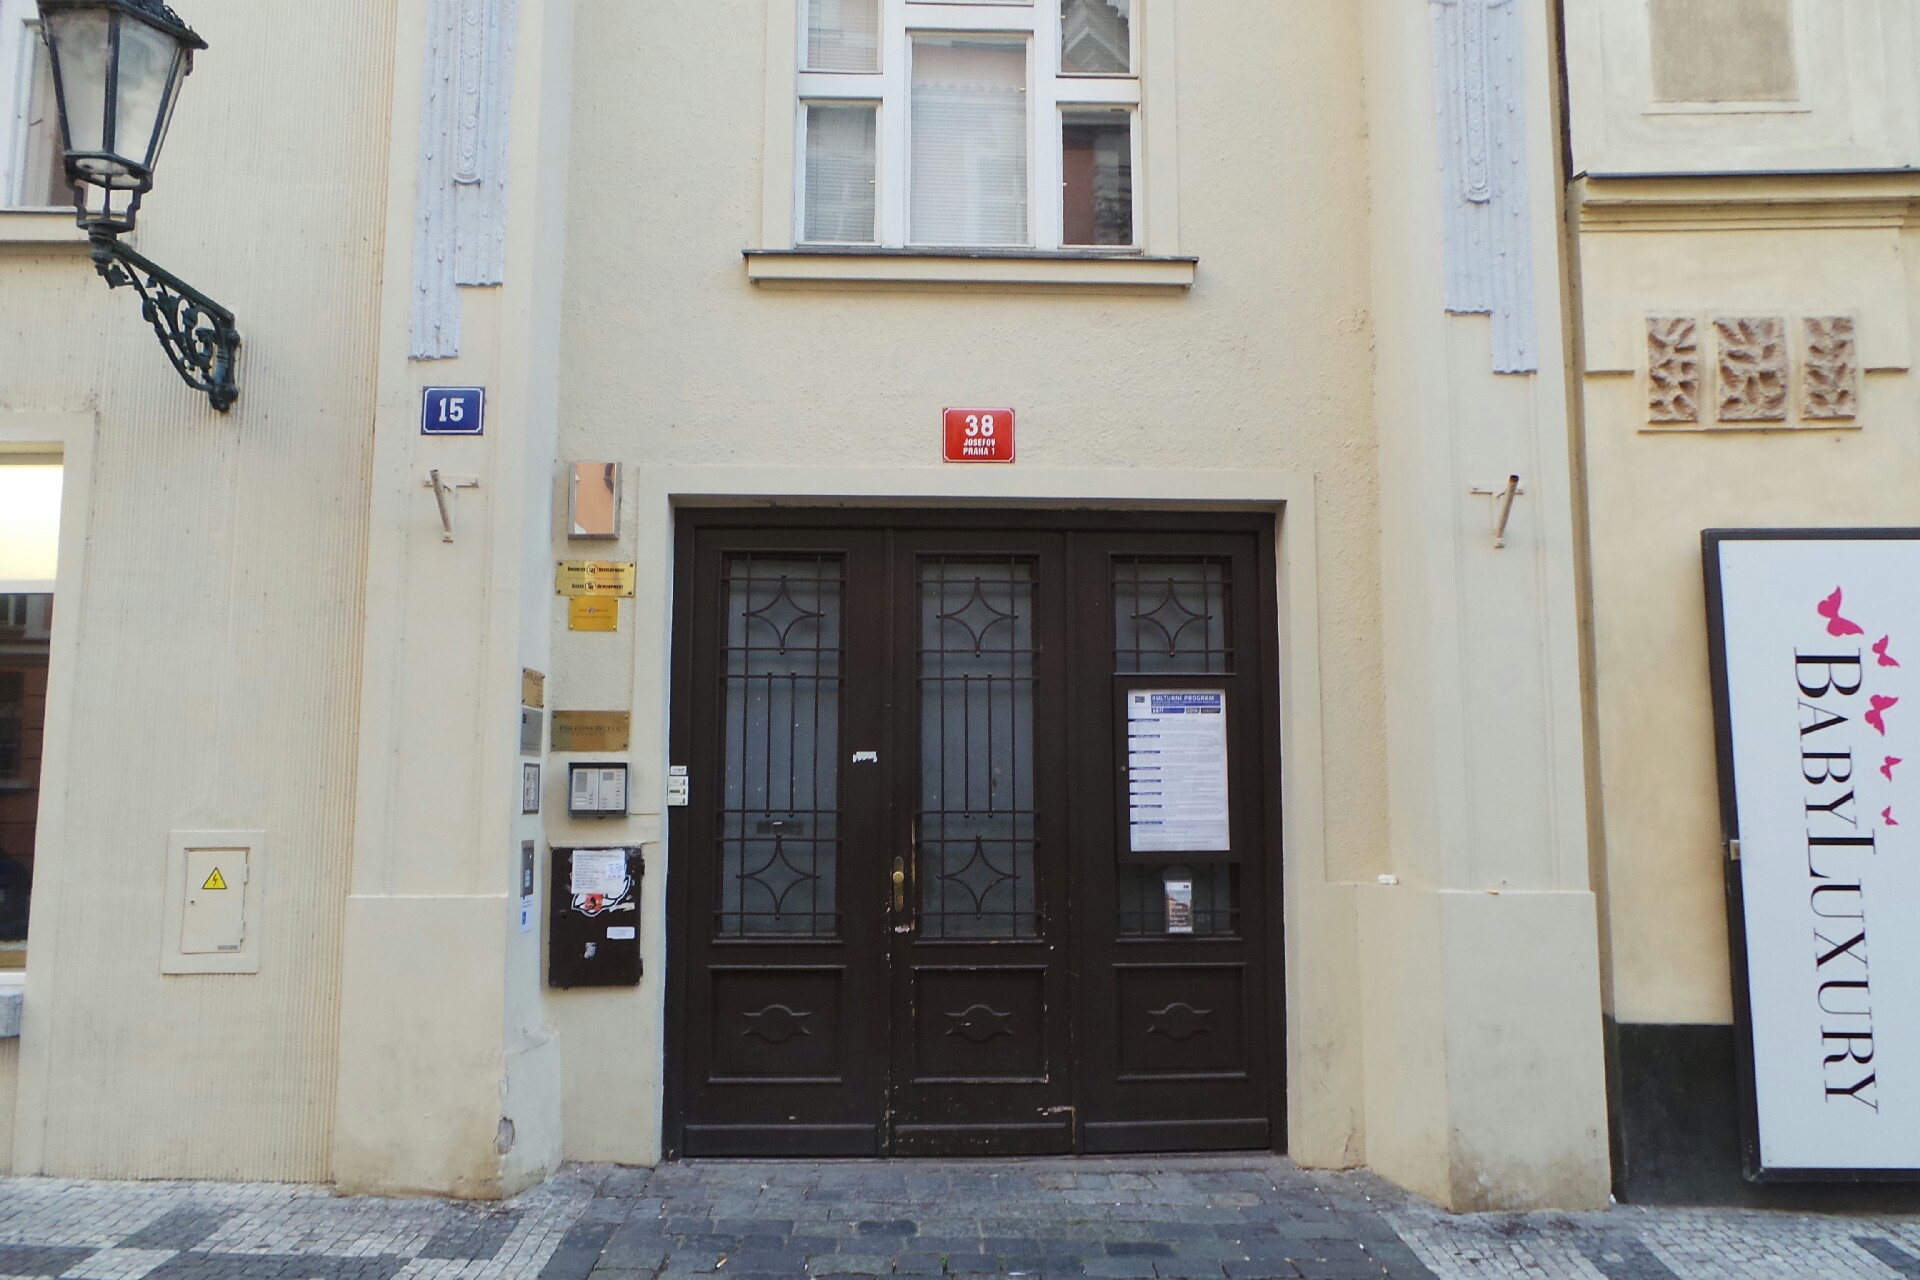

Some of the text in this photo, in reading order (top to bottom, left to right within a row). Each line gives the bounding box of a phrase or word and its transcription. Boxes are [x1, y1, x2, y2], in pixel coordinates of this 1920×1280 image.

[439, 397, 465, 422] 15
[965, 414, 994, 437] 38
[963, 438, 996, 447] JOSEFOV
[963, 447, 995, 456] PRAHA 1
